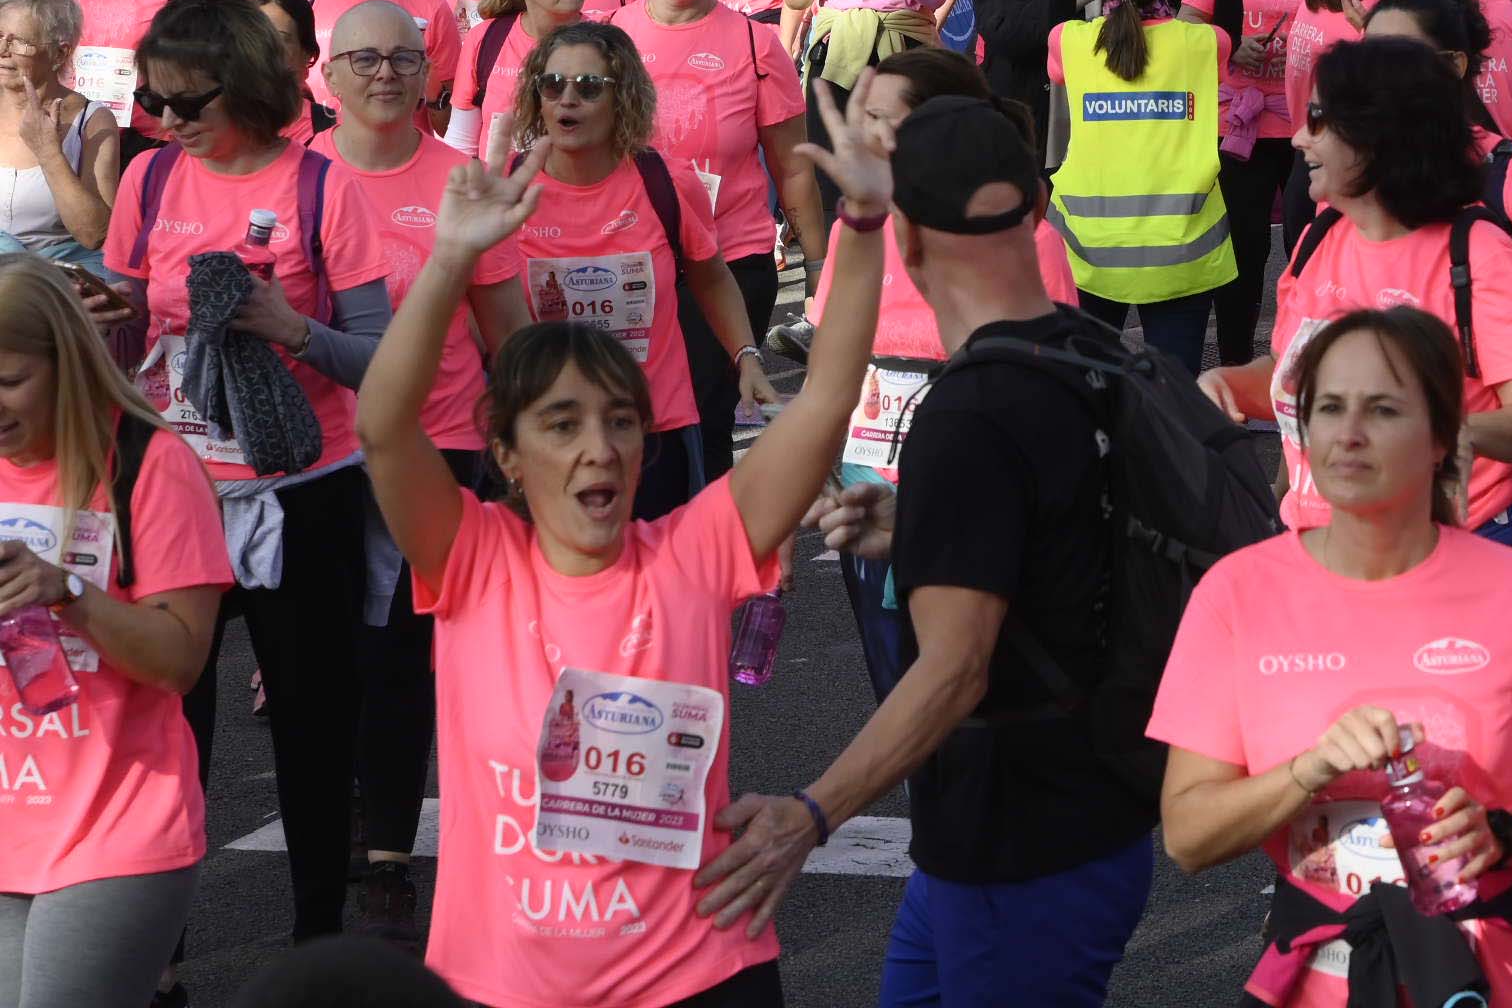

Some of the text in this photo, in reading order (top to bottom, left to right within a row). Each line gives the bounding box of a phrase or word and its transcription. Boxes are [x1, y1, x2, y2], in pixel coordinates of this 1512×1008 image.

[1086, 99, 1184, 114] VOLUNTARIS
[568, 276, 613, 286] ASTURIANA
[572, 300, 614, 316] 016
[1259, 653, 1346, 676] OYSHO
[589, 704, 657, 727] ASTURIANA
[672, 710, 707, 722] SUMA
[585, 746, 647, 776] 016
[593, 781, 628, 800] 5779
[542, 799, 590, 813] CARRERA
[592, 805, 605, 815] DE
[608, 807, 620, 817] LA
[622, 809, 656, 822] MUJER
[538, 823, 685, 853] OYSHO Santander
